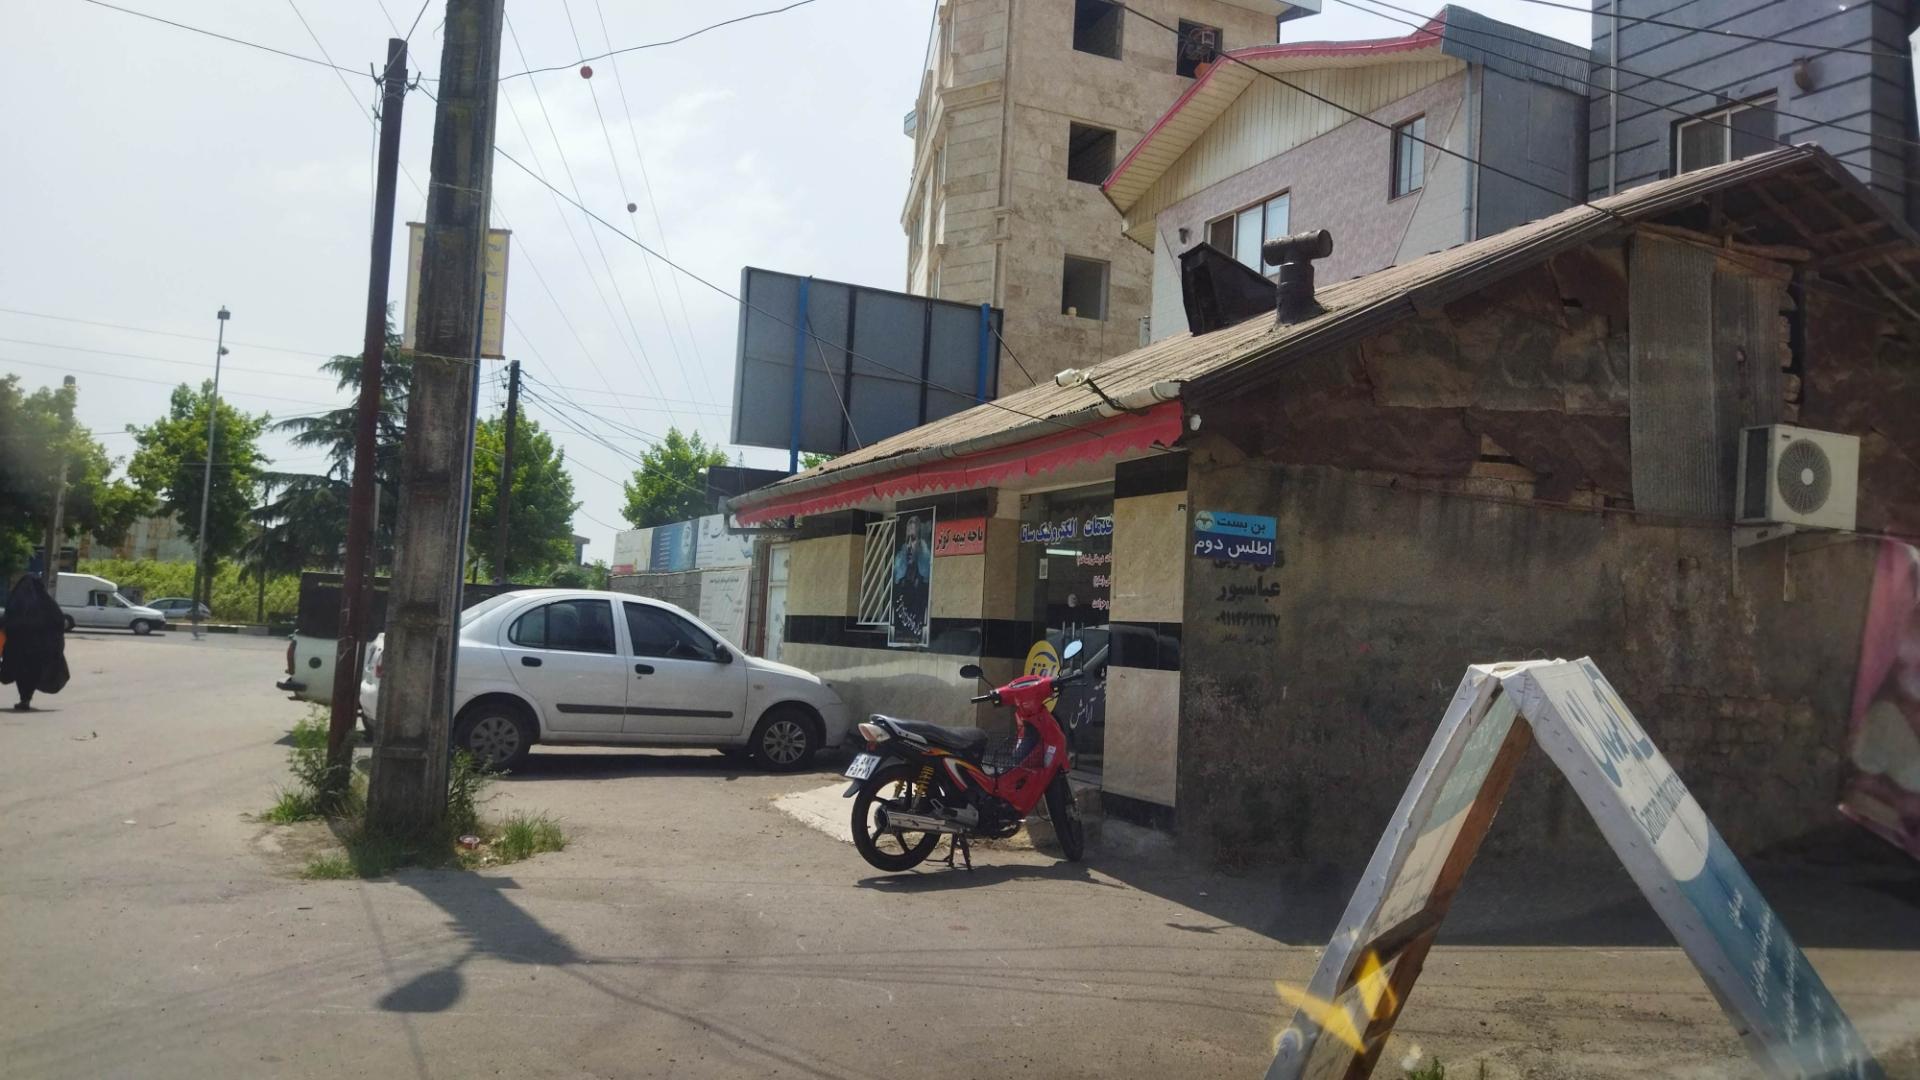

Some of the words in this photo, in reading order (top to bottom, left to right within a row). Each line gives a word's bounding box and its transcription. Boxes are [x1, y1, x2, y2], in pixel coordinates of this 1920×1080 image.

[1217, 517, 1248, 532] بست
[1251, 523, 1266, 535] بن
[1194, 538, 1224, 555] دوم
[1228, 540, 1272, 558] اطلس
[1630, 797, 1670, 845] Saman
